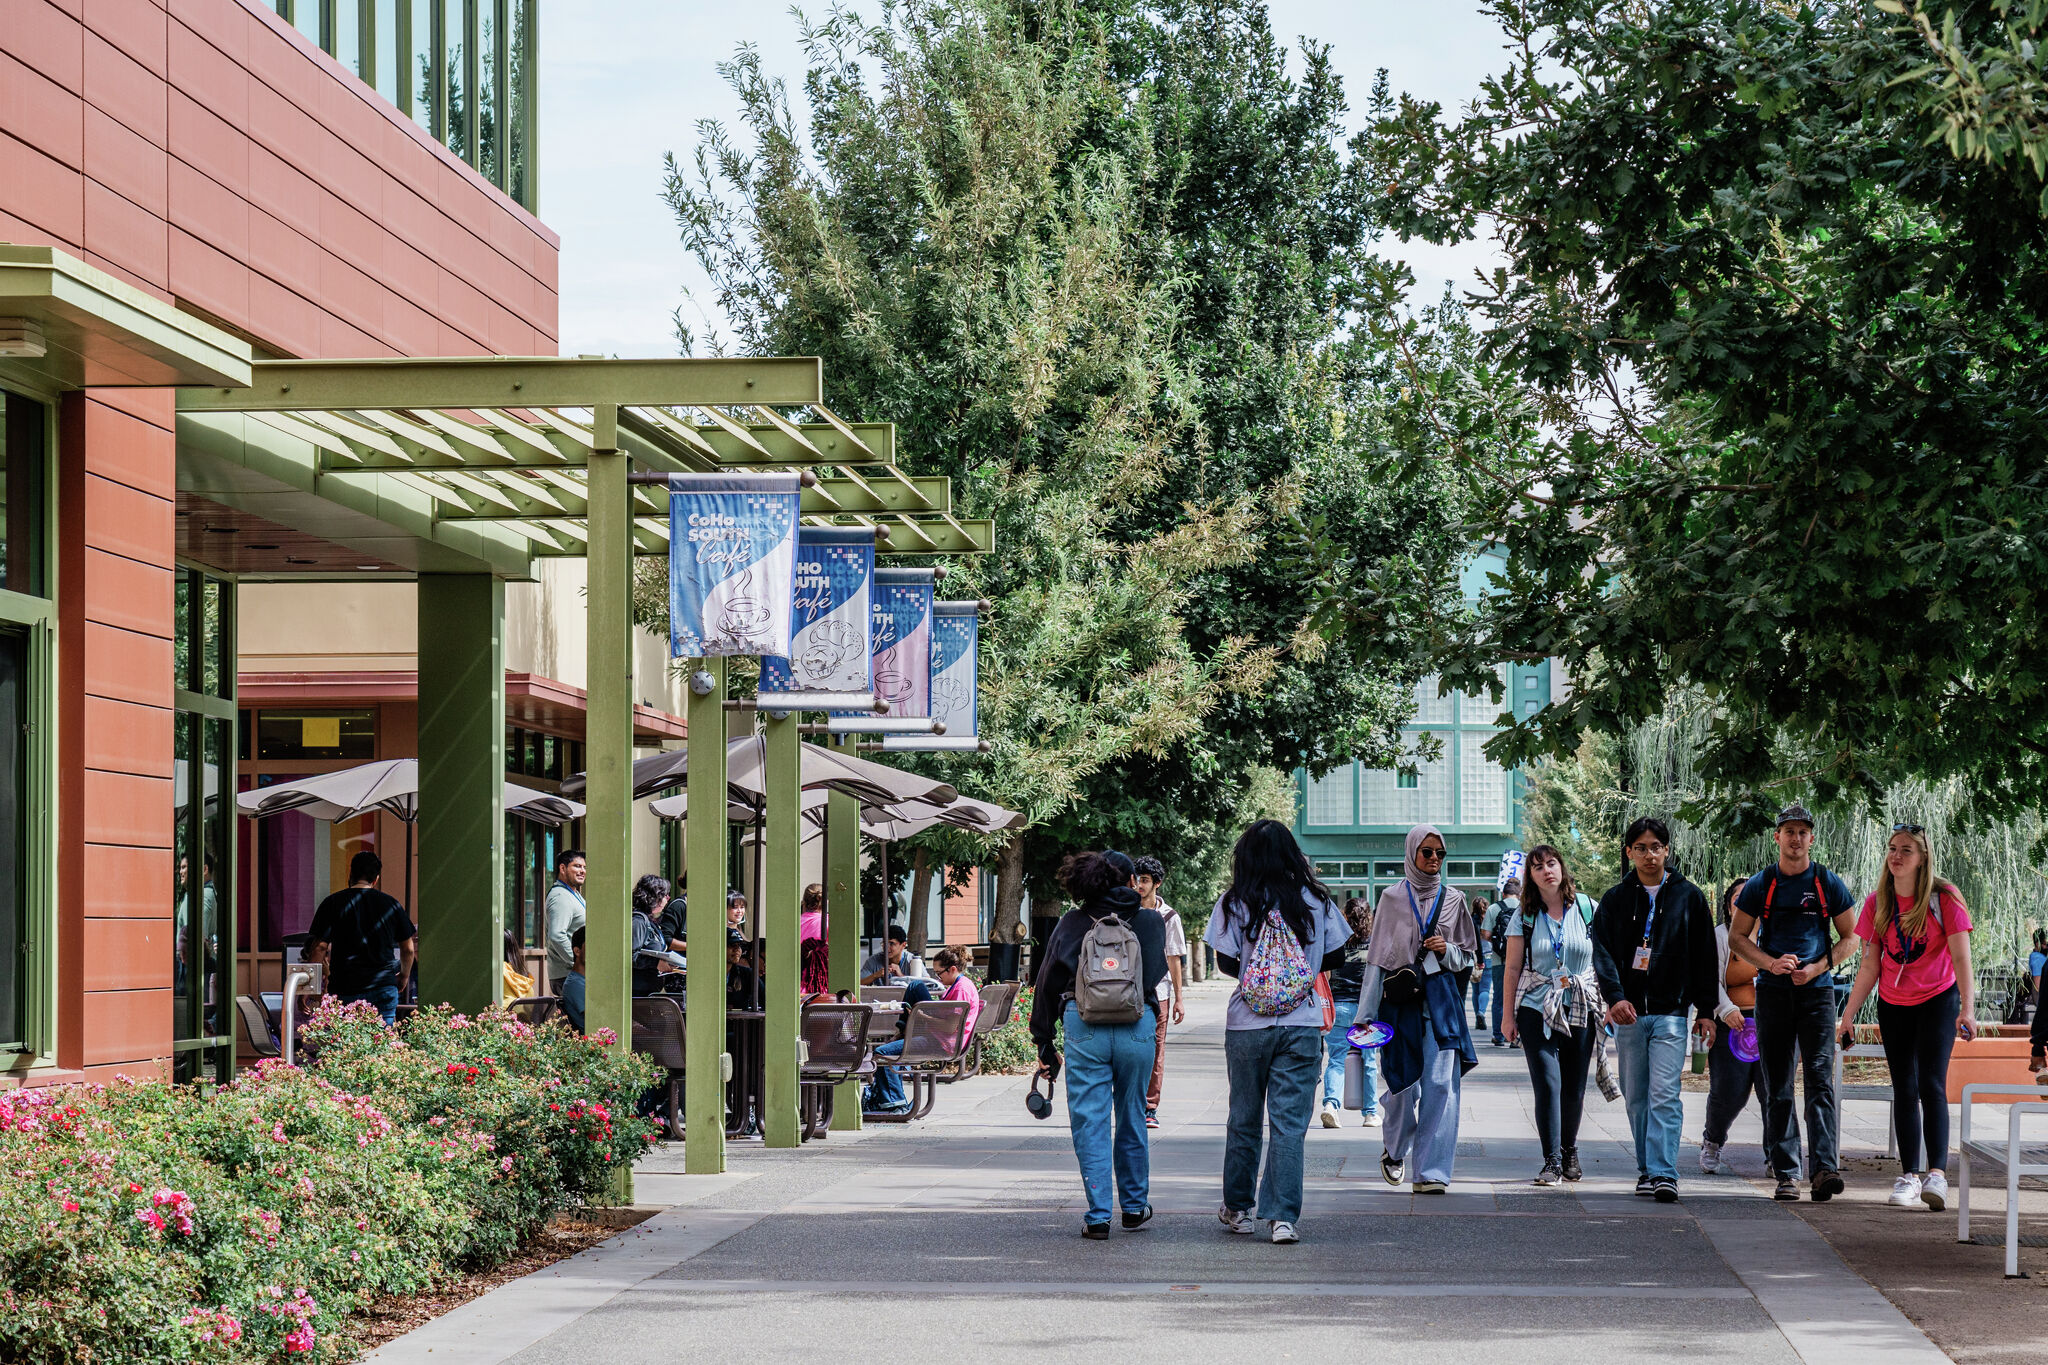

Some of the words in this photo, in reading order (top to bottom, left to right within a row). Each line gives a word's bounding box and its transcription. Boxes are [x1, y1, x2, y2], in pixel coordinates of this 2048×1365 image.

[688, 528, 750, 541] SOUTH
[696, 535, 752, 578] Café
[797, 562, 822, 575] HO
[795, 576, 830, 589] UTH
